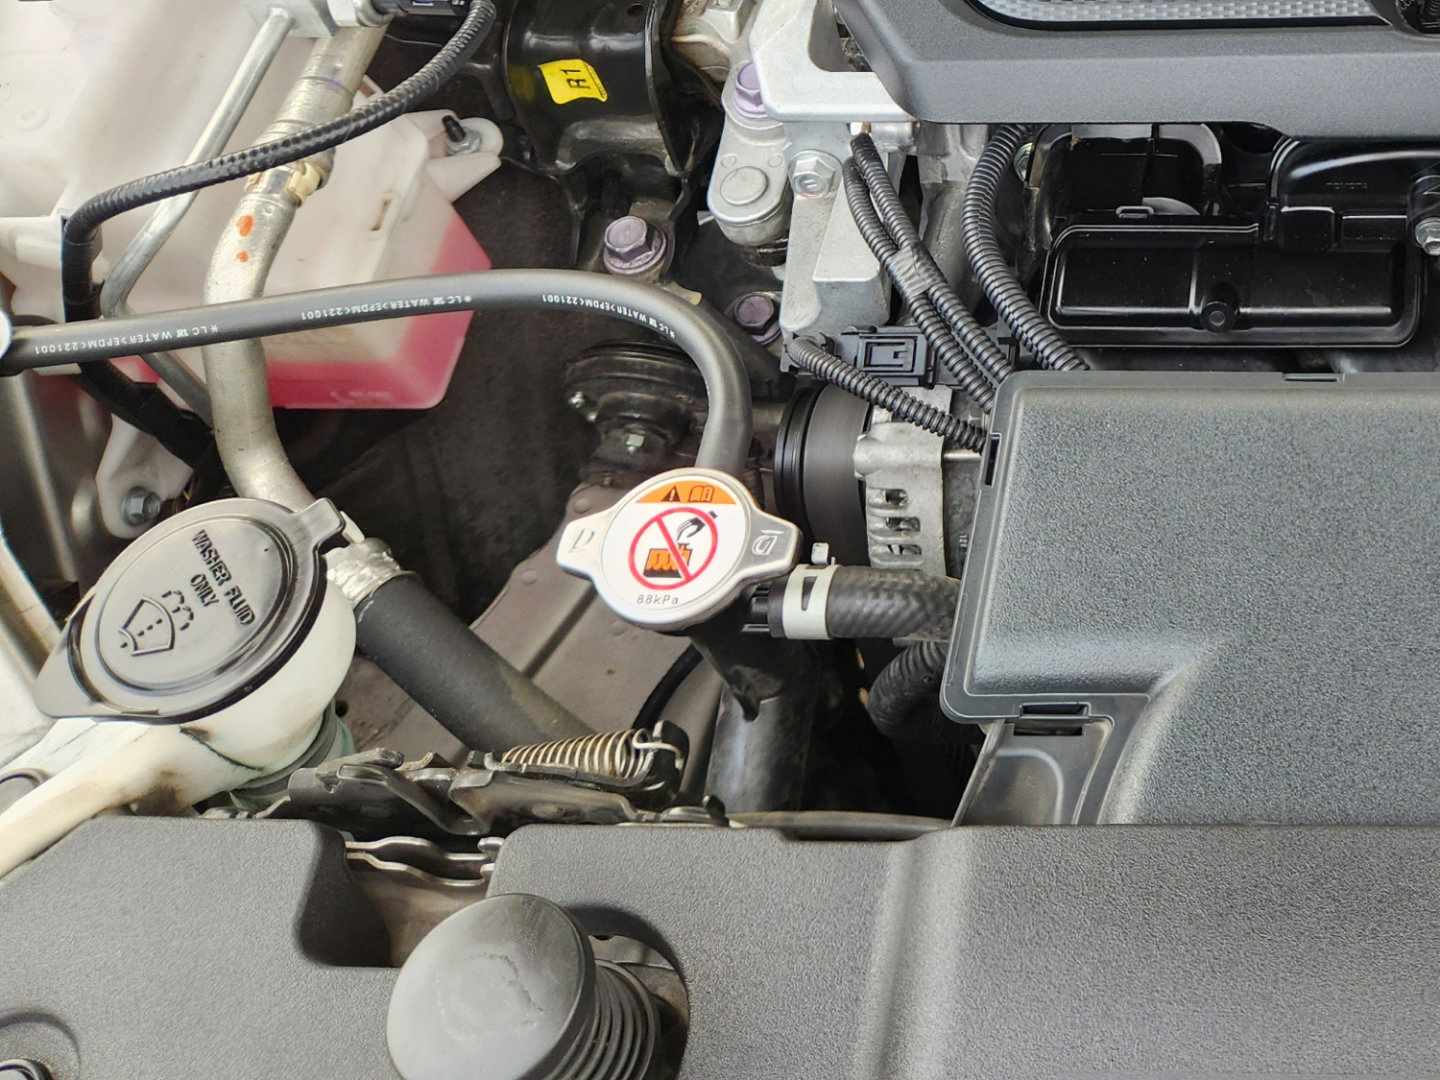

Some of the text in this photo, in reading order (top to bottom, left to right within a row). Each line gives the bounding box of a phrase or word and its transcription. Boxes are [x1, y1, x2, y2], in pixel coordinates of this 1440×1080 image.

[560, 69, 591, 89] R1
[190, 573, 220, 607] ONLY
[192, 529, 256, 626] WASHER FLUID
[636, 593, 680, 605] 88kPa
